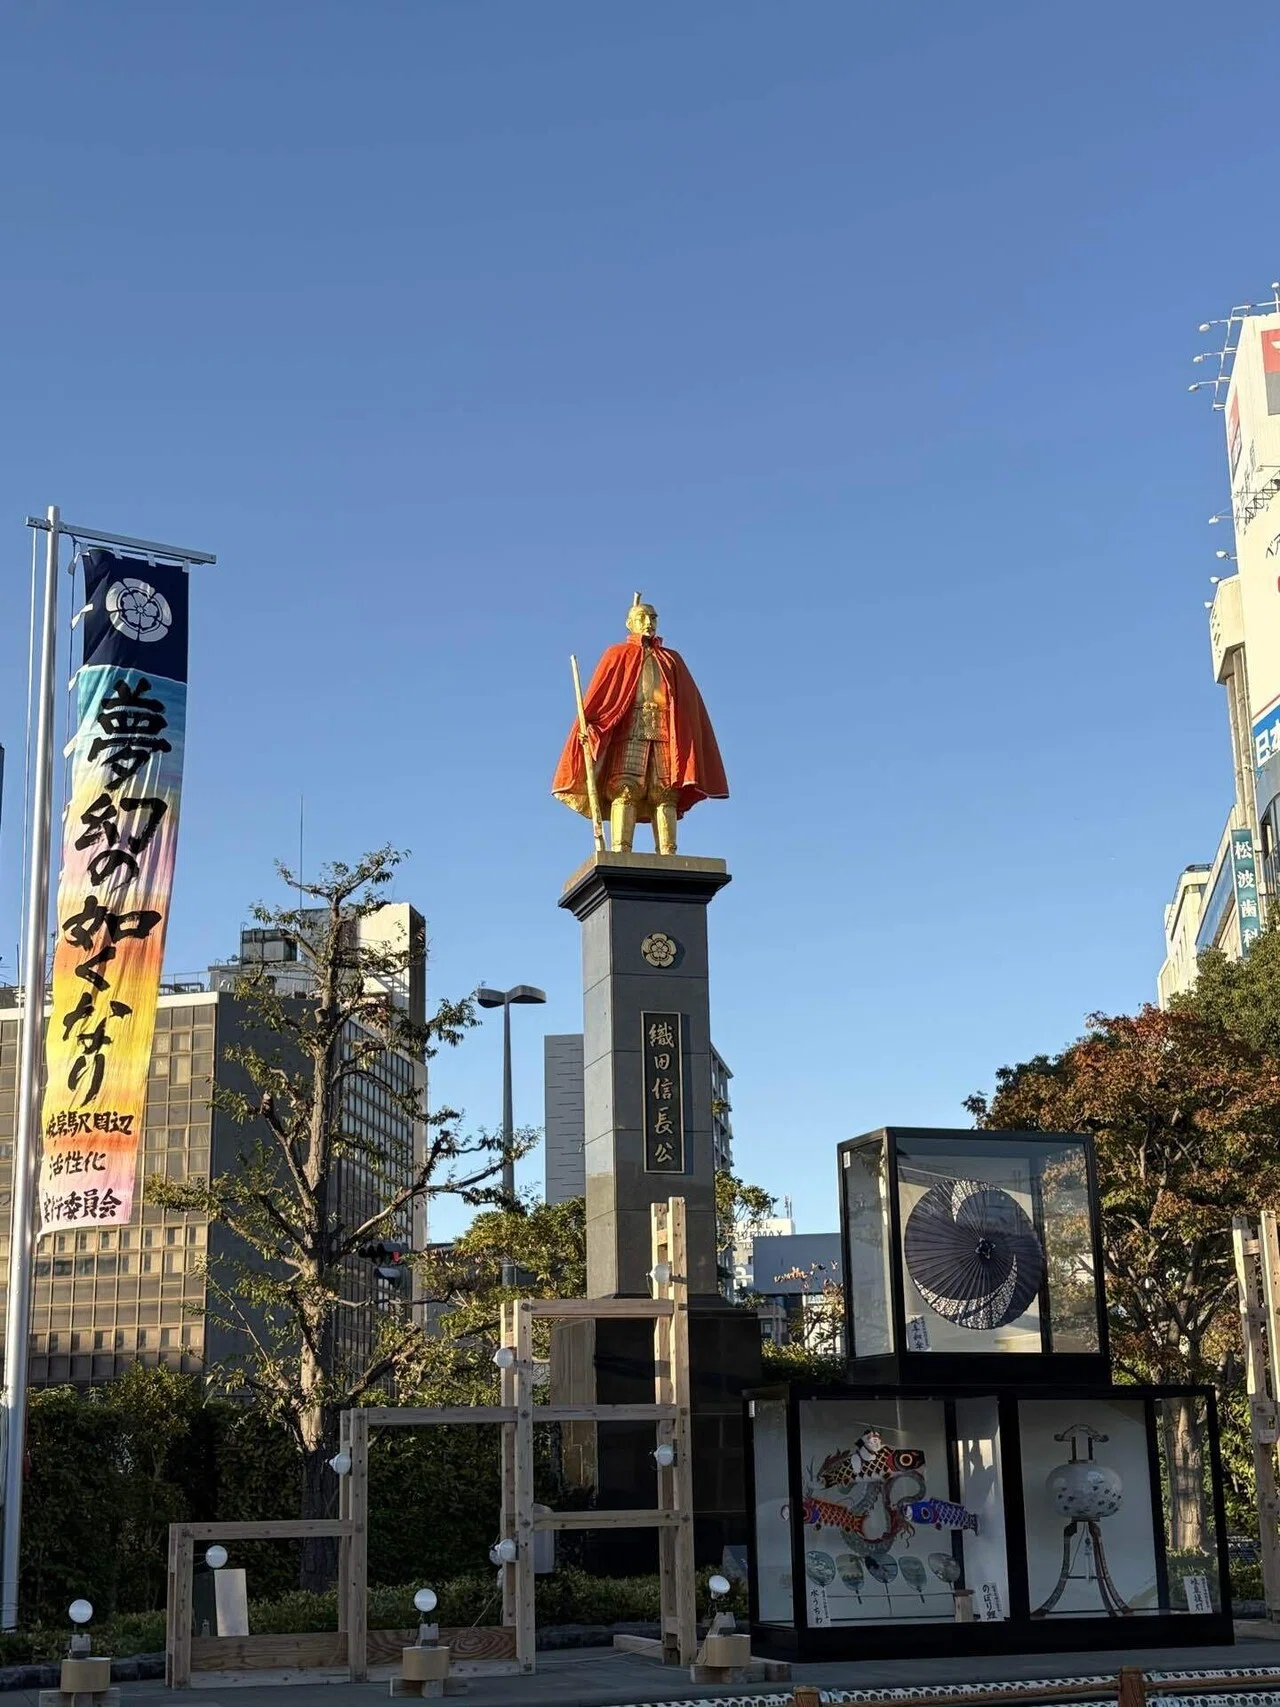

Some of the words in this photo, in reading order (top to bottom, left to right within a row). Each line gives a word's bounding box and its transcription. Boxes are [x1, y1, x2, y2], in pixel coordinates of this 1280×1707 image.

[62, 677, 172, 1109] 夢幻の如くなり
[649, 1022, 675, 1163] 織田信長公
[49, 1150, 106, 1180] 活性化
